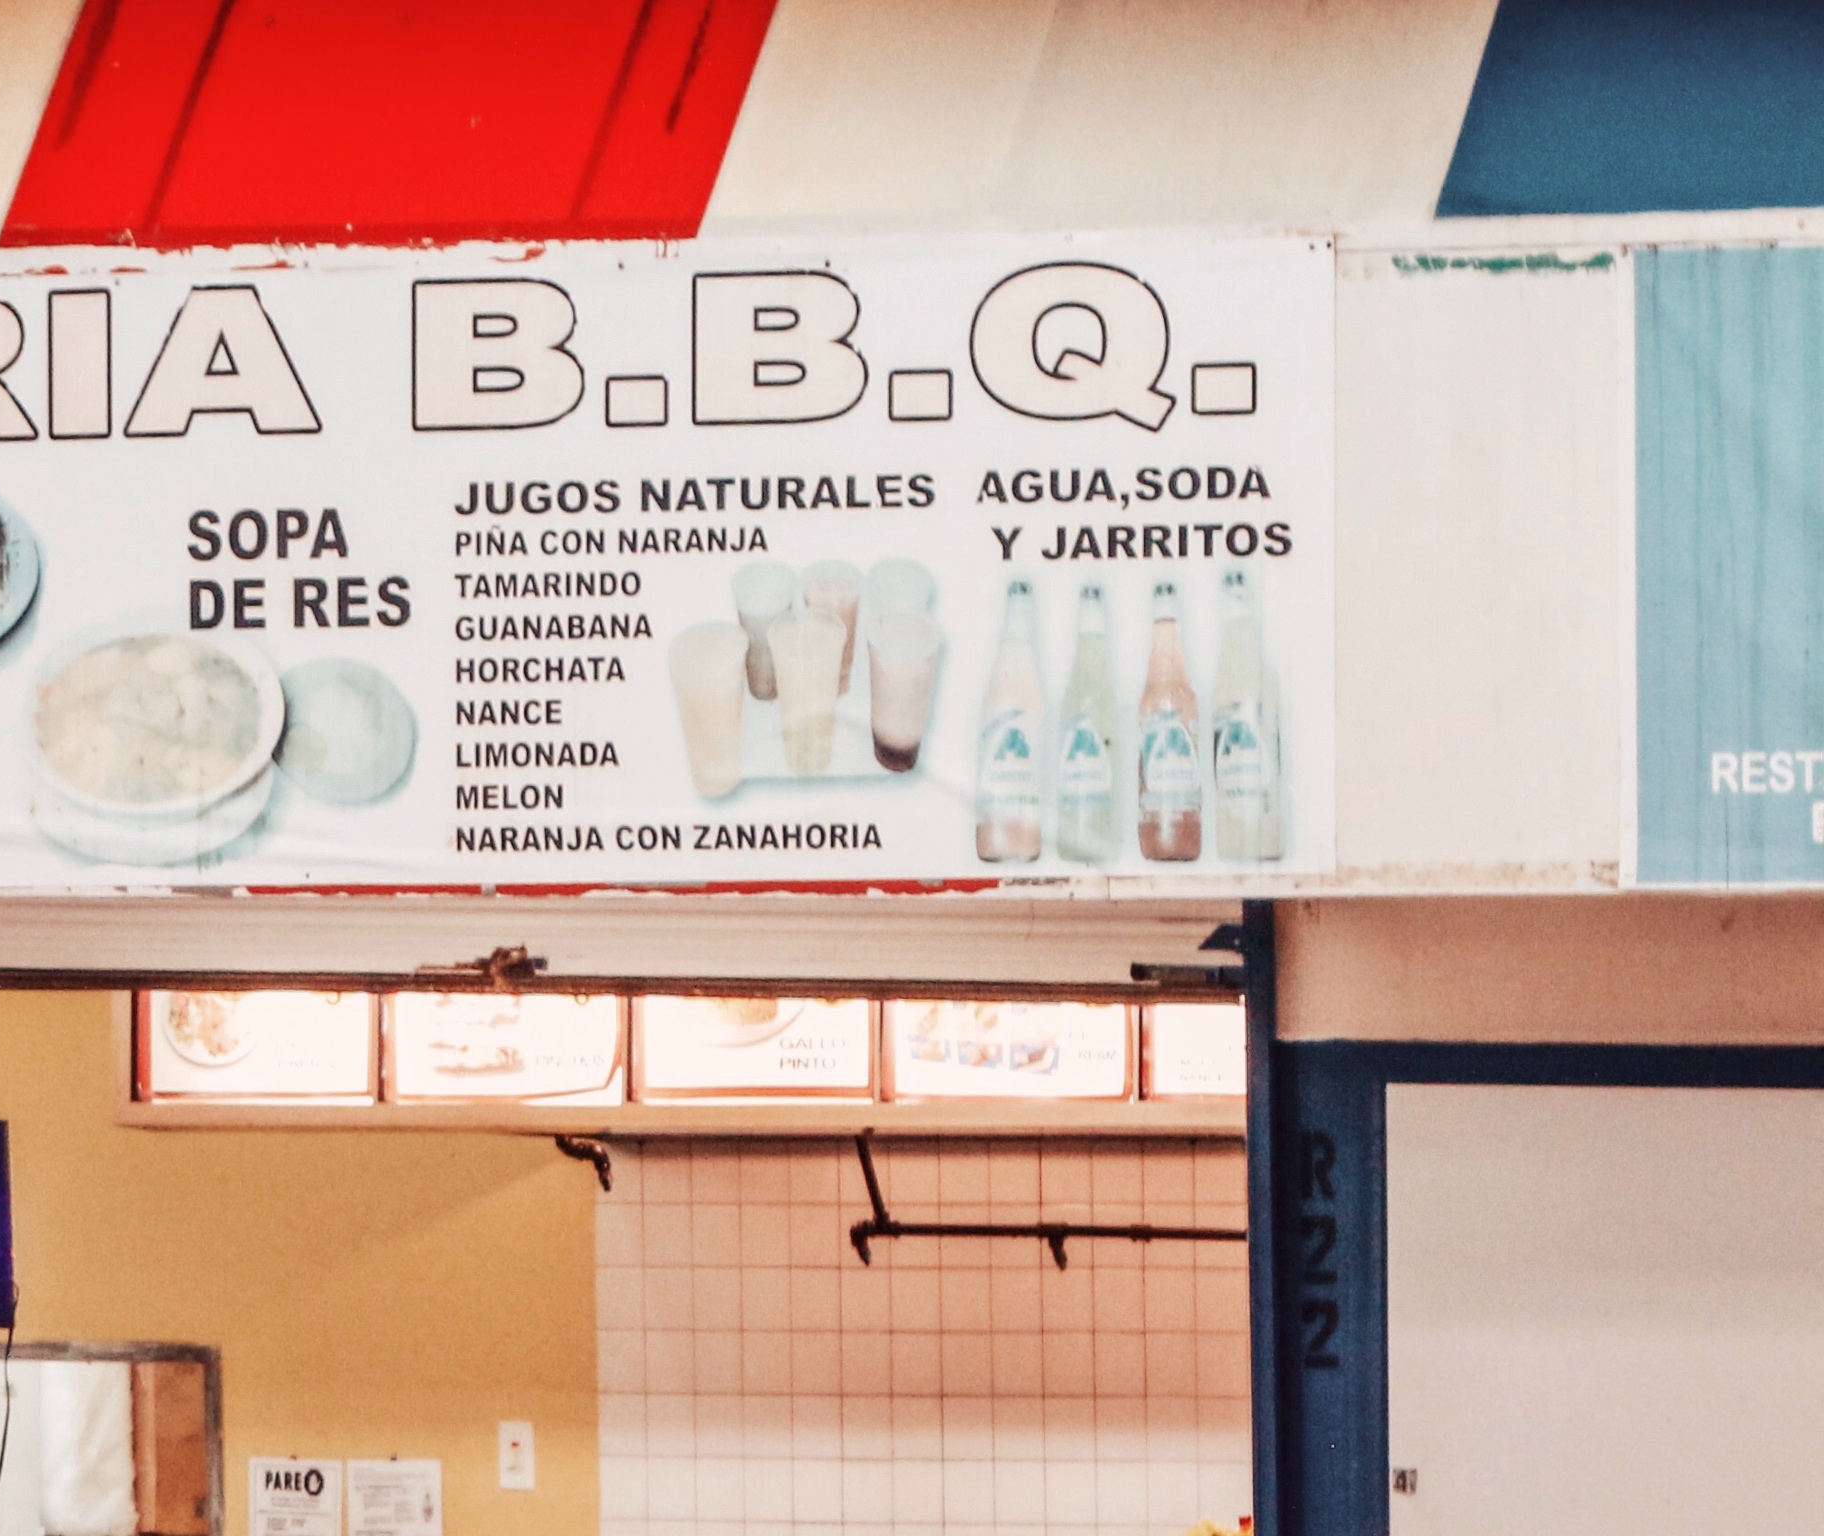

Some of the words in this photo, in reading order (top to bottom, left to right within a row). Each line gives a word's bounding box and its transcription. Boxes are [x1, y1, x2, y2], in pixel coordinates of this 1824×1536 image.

[411, 259, 1258, 433] B.B.Q.
[454, 480, 621, 516] JUGOS
[640, 474, 936, 512] NATURALES
[187, 508, 348, 562] SOPA
[455, 525, 528, 557] PIÑA
[540, 529, 605, 556] CON
[618, 527, 768, 554] NARANJA
[991, 527, 1022, 561] Y
[1041, 522, 1293, 560] JARRITOS
[454, 571, 641, 599] TAMARINDO
[189, 579, 266, 630] DE
[293, 575, 411, 628] RES
[455, 614, 652, 642] GUANABANA
[456, 657, 625, 683] HORCHATA
[456, 699, 562, 726] NANCE
[456, 742, 619, 768] LIMONADA
[456, 784, 563, 810] MELON
[456, 826, 604, 852] NARANJA
[615, 825, 681, 851] CON
[693, 823, 882, 850] ZANAHORIA
[264, 1470, 302, 1492] PARE
